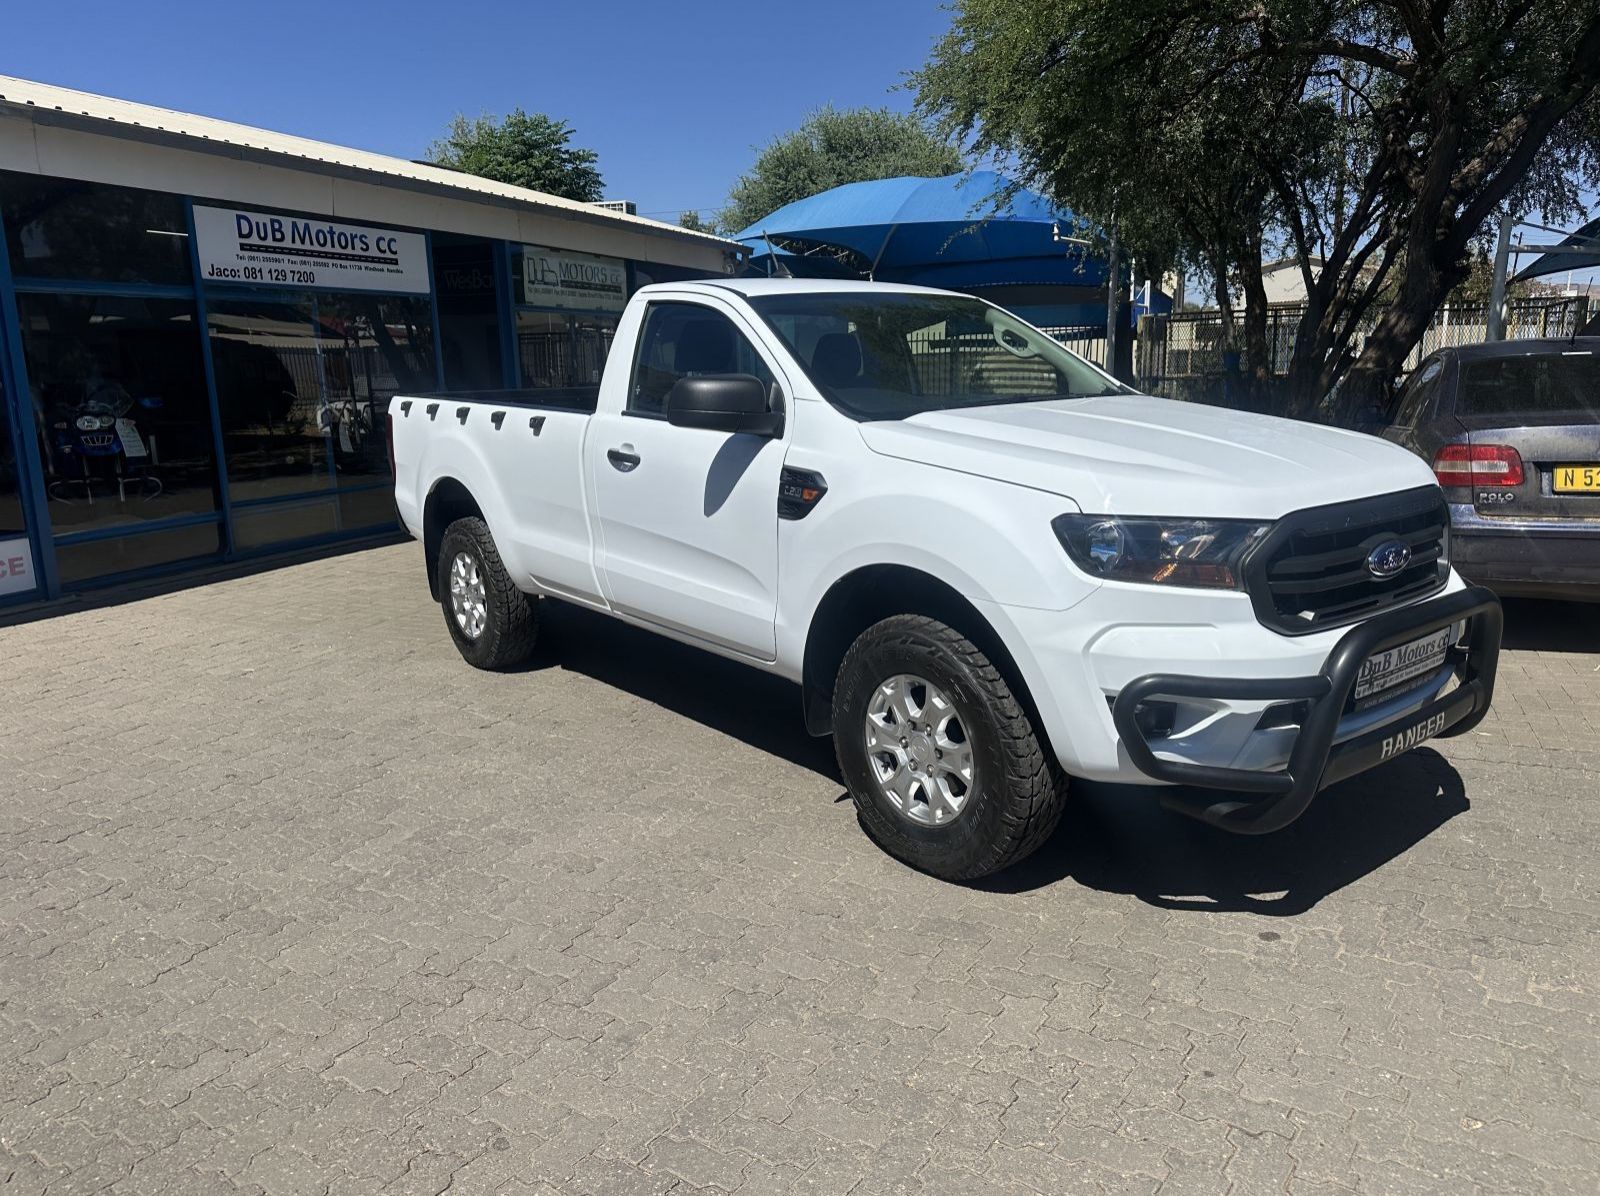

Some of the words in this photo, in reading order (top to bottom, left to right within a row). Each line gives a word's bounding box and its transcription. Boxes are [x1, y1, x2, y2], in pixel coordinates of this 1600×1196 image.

[236, 213, 285, 243] DuB
[291, 221, 369, 252] Motors
[376, 236, 398, 255] cc
[208, 263, 241, 279] Jaco:
[243, 266, 263, 280] 081
[267, 268, 287, 282] 129
[290, 269, 315, 284] 7200
[559, 262, 607, 284] MOTORS
[1564, 469, 1574, 487] N
[1359, 652, 1392, 679] DuB
[1395, 639, 1435, 667] Motors
[1380, 712, 1445, 759] RANGER
